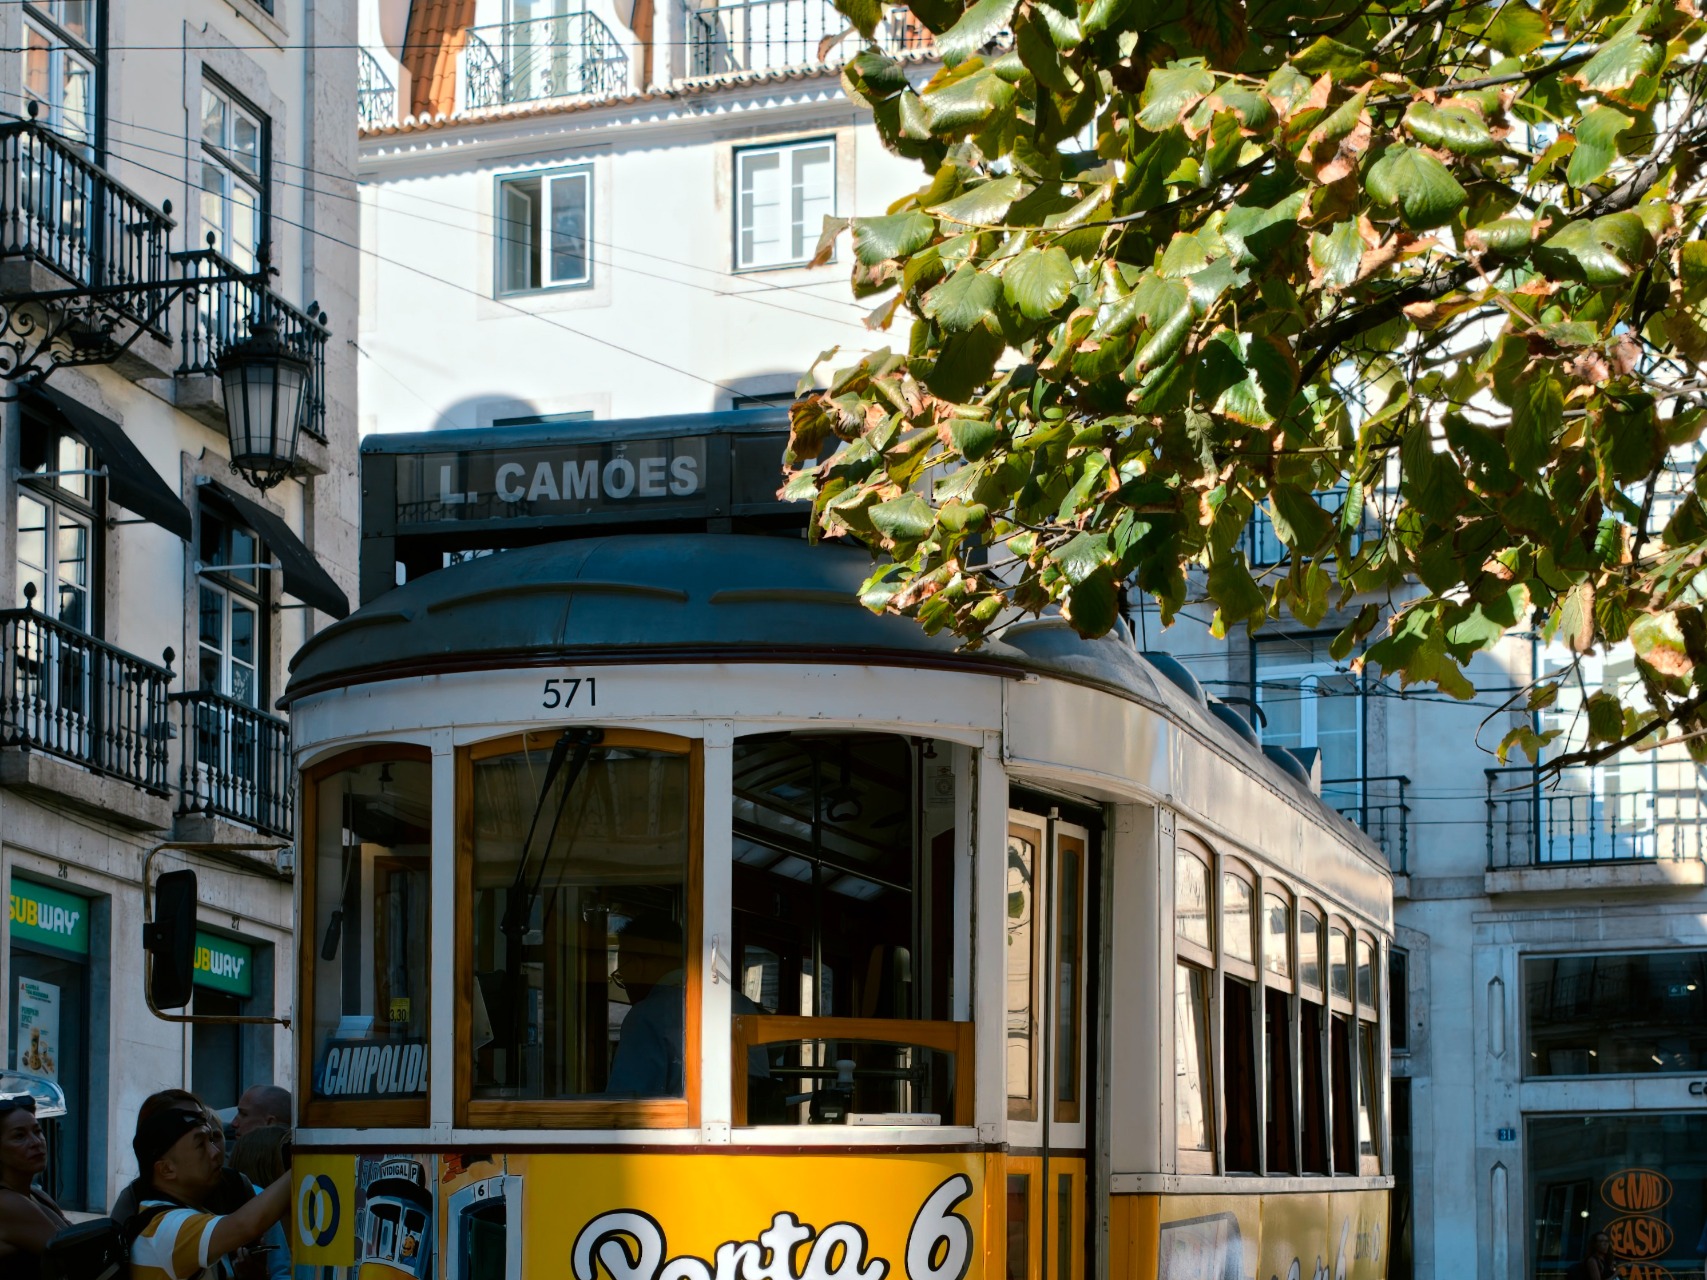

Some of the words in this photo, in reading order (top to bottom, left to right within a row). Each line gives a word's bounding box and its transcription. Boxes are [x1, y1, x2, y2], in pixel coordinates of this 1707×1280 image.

[440, 465, 477, 504] L.
[495, 454, 699, 503] CAMÕES
[542, 677, 596, 709] 571
[58, 864, 68, 879] 26
[9, 894, 80, 936] SUBWAY
[193, 946, 245, 979] UBWAY
[1500, 1128, 1511, 1141] 31
[382, 1164, 408, 1177] VIDIGAL
[411, 1167, 417, 1180] P
[478, 1184, 485, 1197] 6
[1627, 1172, 1663, 1210] MID
[1610, 1218, 1665, 1257] SEASON
